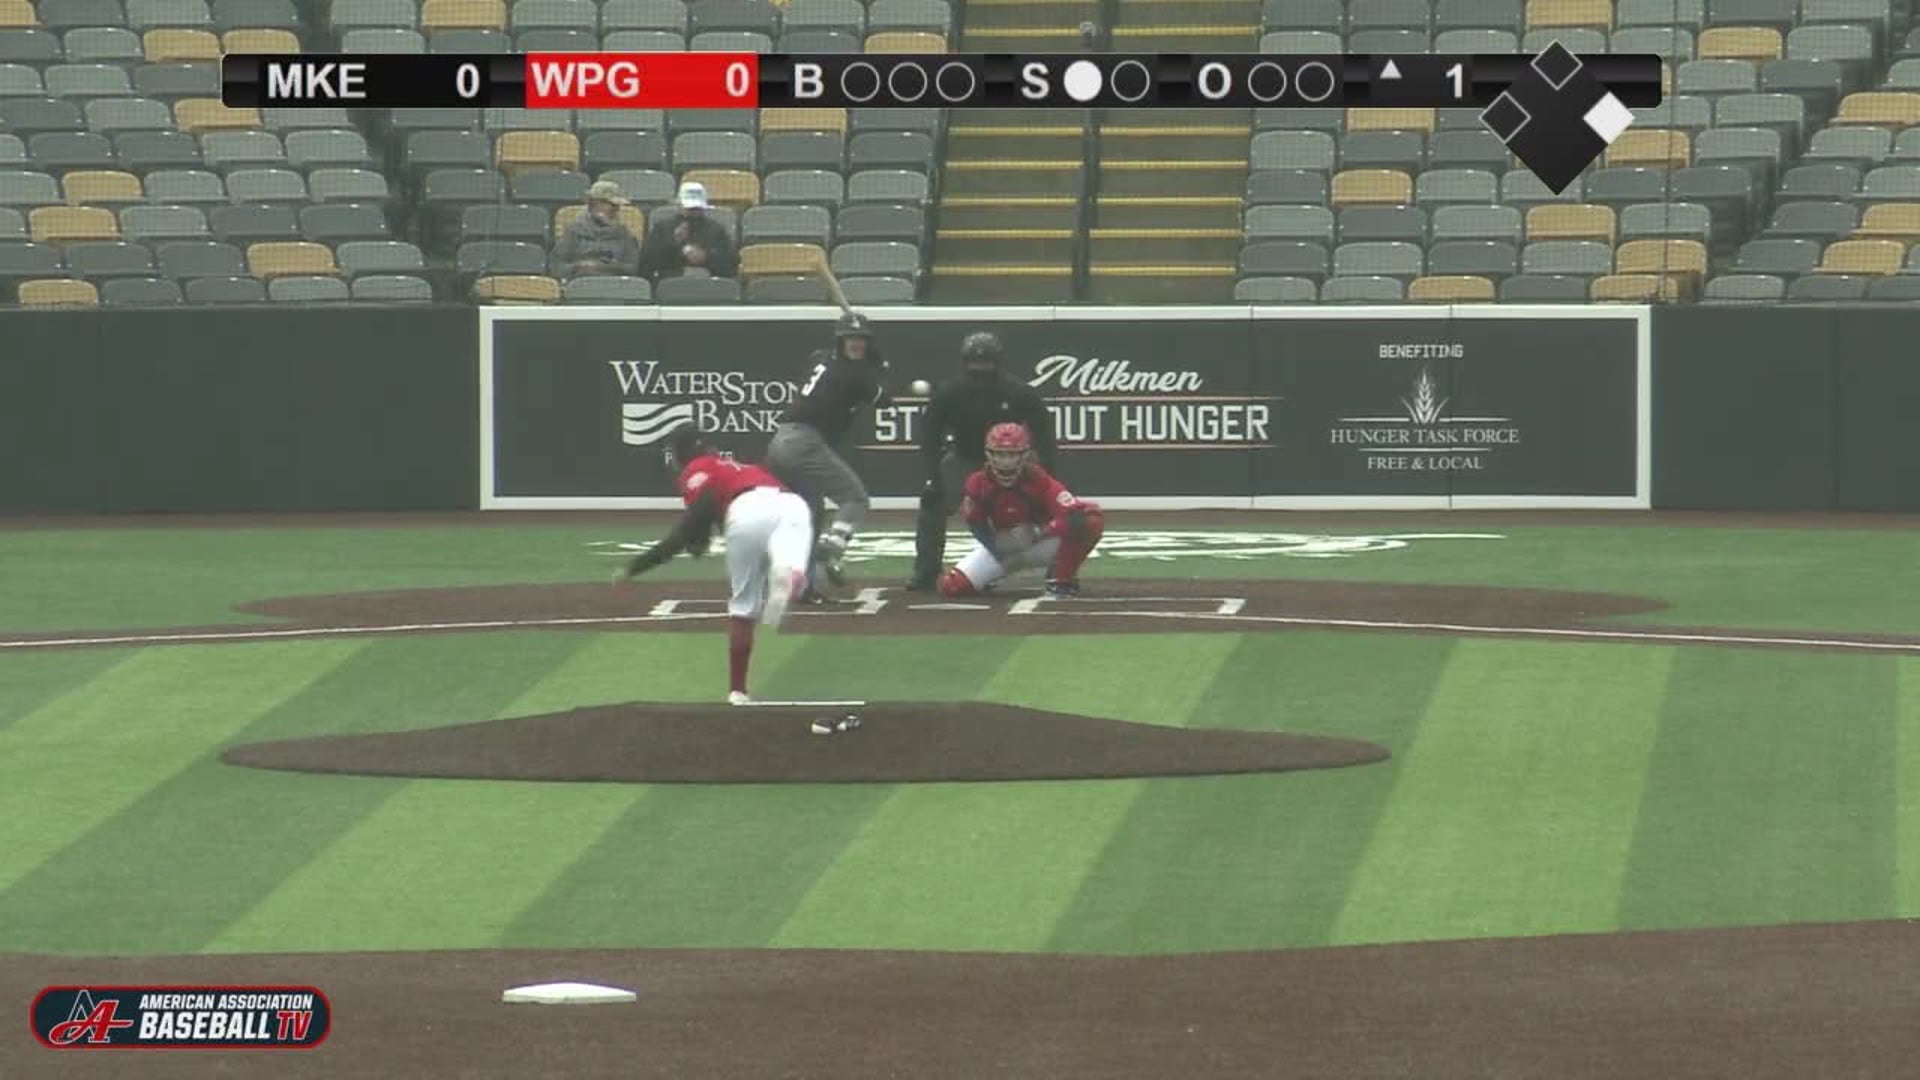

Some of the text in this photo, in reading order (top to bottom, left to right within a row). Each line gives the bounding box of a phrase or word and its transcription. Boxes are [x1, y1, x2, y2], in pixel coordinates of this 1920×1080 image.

[1379, 344, 1464, 358] BENEFITING
[608, 360, 798, 406] WATERSTO
[1027, 355, 1203, 395] Milkmen
[696, 400, 784, 433] BANK
[1121, 405, 1270, 441] HUNGER
[1330, 428, 1520, 444] HUNGER TASK FORCE
[1367, 456, 1484, 470] FREE & LOCAL
